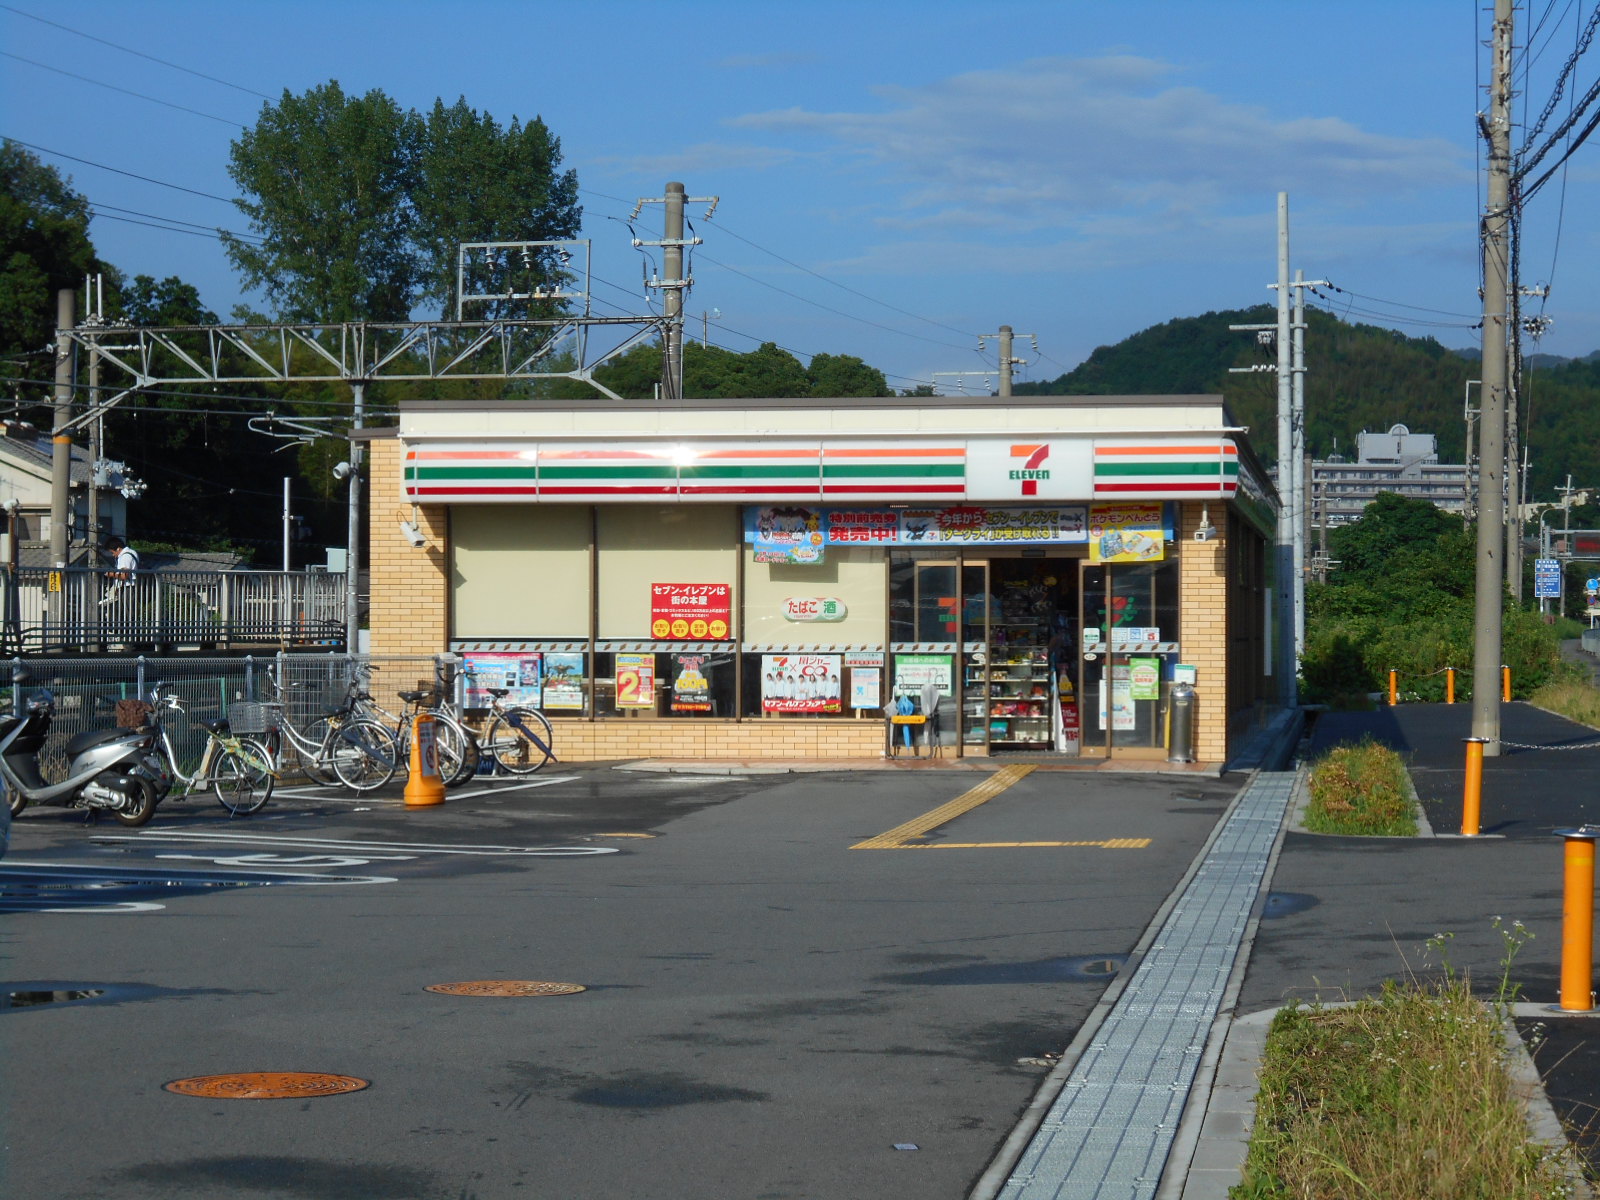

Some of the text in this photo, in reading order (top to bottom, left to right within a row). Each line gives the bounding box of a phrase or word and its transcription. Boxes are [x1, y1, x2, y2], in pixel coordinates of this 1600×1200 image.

[1010, 444, 1049, 496] 7
[942, 512, 983, 525] 今年から
[1090, 513, 1160, 523] ポケモンべんとう
[829, 526, 897, 541] 発売中!
[671, 596, 708, 605] 街の本屋
[788, 601, 837, 614] たばこ 酒
[619, 671, 639, 702] 2
